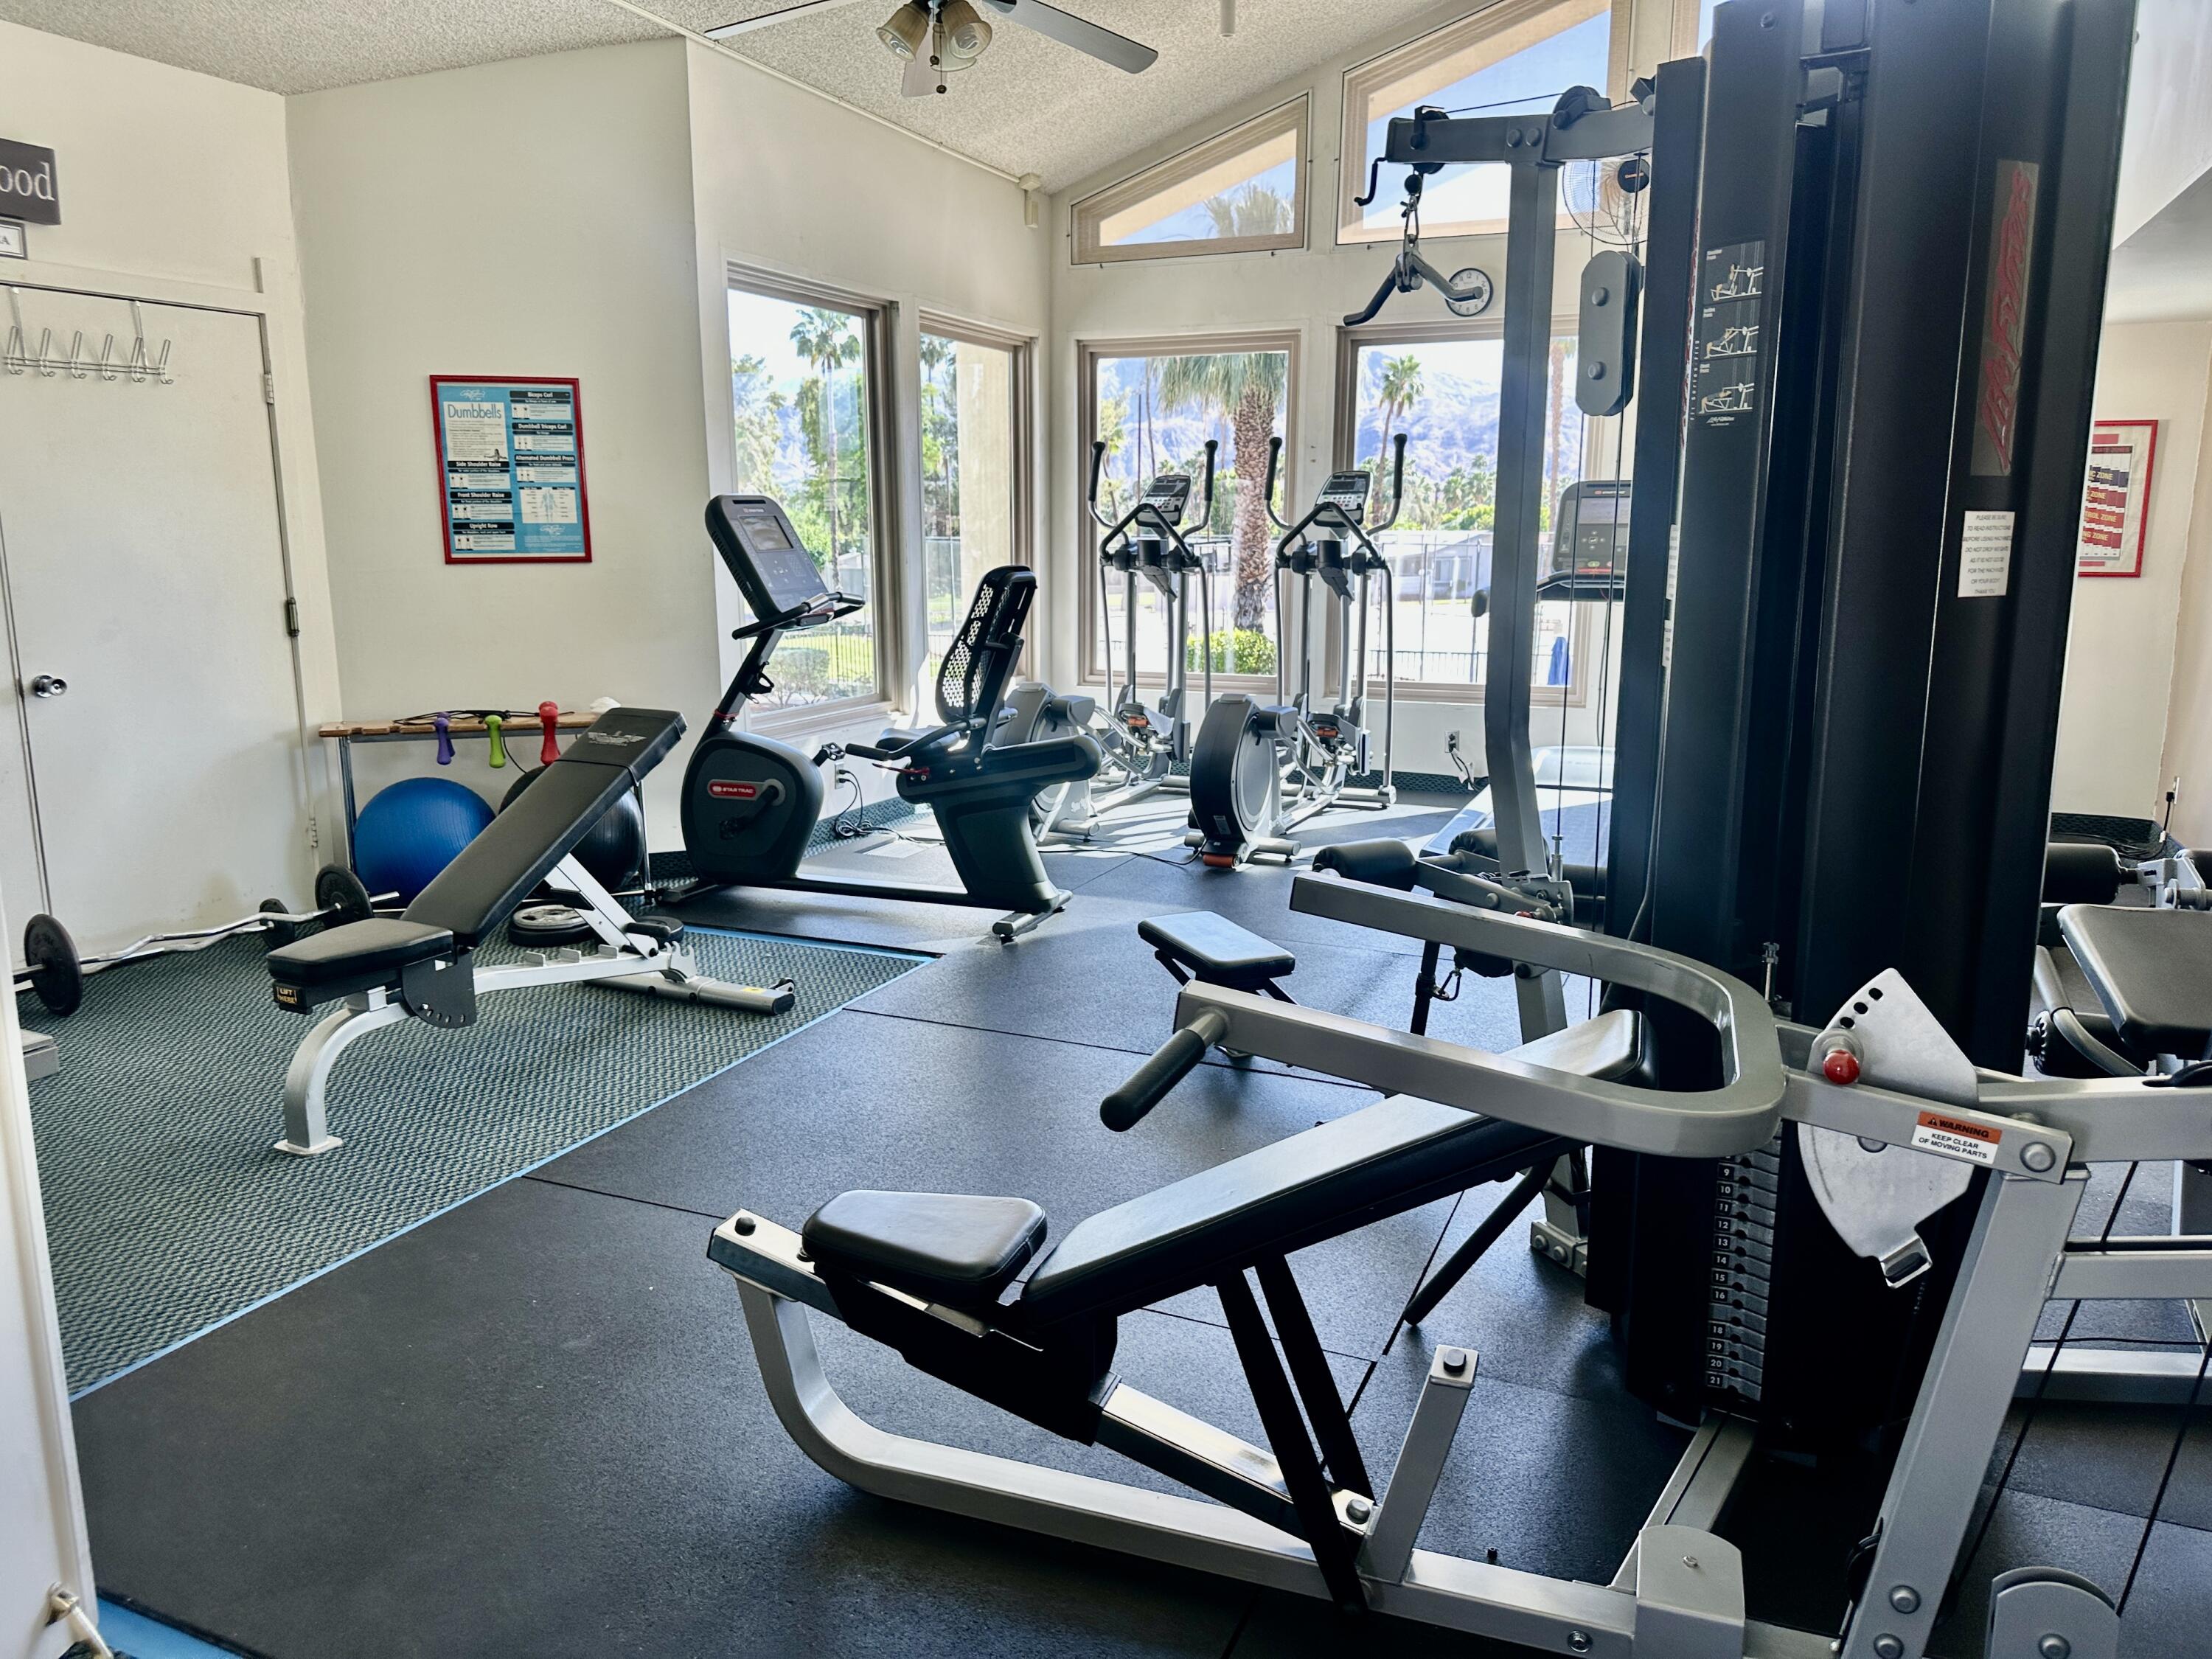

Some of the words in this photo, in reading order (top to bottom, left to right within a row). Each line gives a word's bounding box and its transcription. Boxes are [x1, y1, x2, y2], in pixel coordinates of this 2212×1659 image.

[448, 404, 502, 419] Dumbbells
[2097, 472, 2113, 480] ZONE
[2090, 491, 2107, 499] ZONE
[2100, 513, 2118, 523] ZONE
[2092, 532, 2109, 541] ZONE
[1938, 1119, 1989, 1138] WARNING
[1931, 1133, 1952, 1142] KEEP
[1952, 1138, 1979, 1149] CLEAR
[1930, 1140, 1961, 1152] MOVING
[1961, 1147, 1988, 1159] PARTS
[1721, 1186, 1731, 1194] 10
[1719, 1203, 1728, 1211] 11
[1719, 1220, 1728, 1229] 12
[1718, 1238, 1728, 1246] 13
[1717, 1256, 1727, 1264] 14
[1715, 1273, 1725, 1281] 15
[1715, 1291, 1725, 1299] 16
[1714, 1326, 1722, 1334] 18
[1712, 1342, 1722, 1350] 19
[1711, 1359, 1721, 1368] 20
[1710, 1376, 1720, 1385] 21
